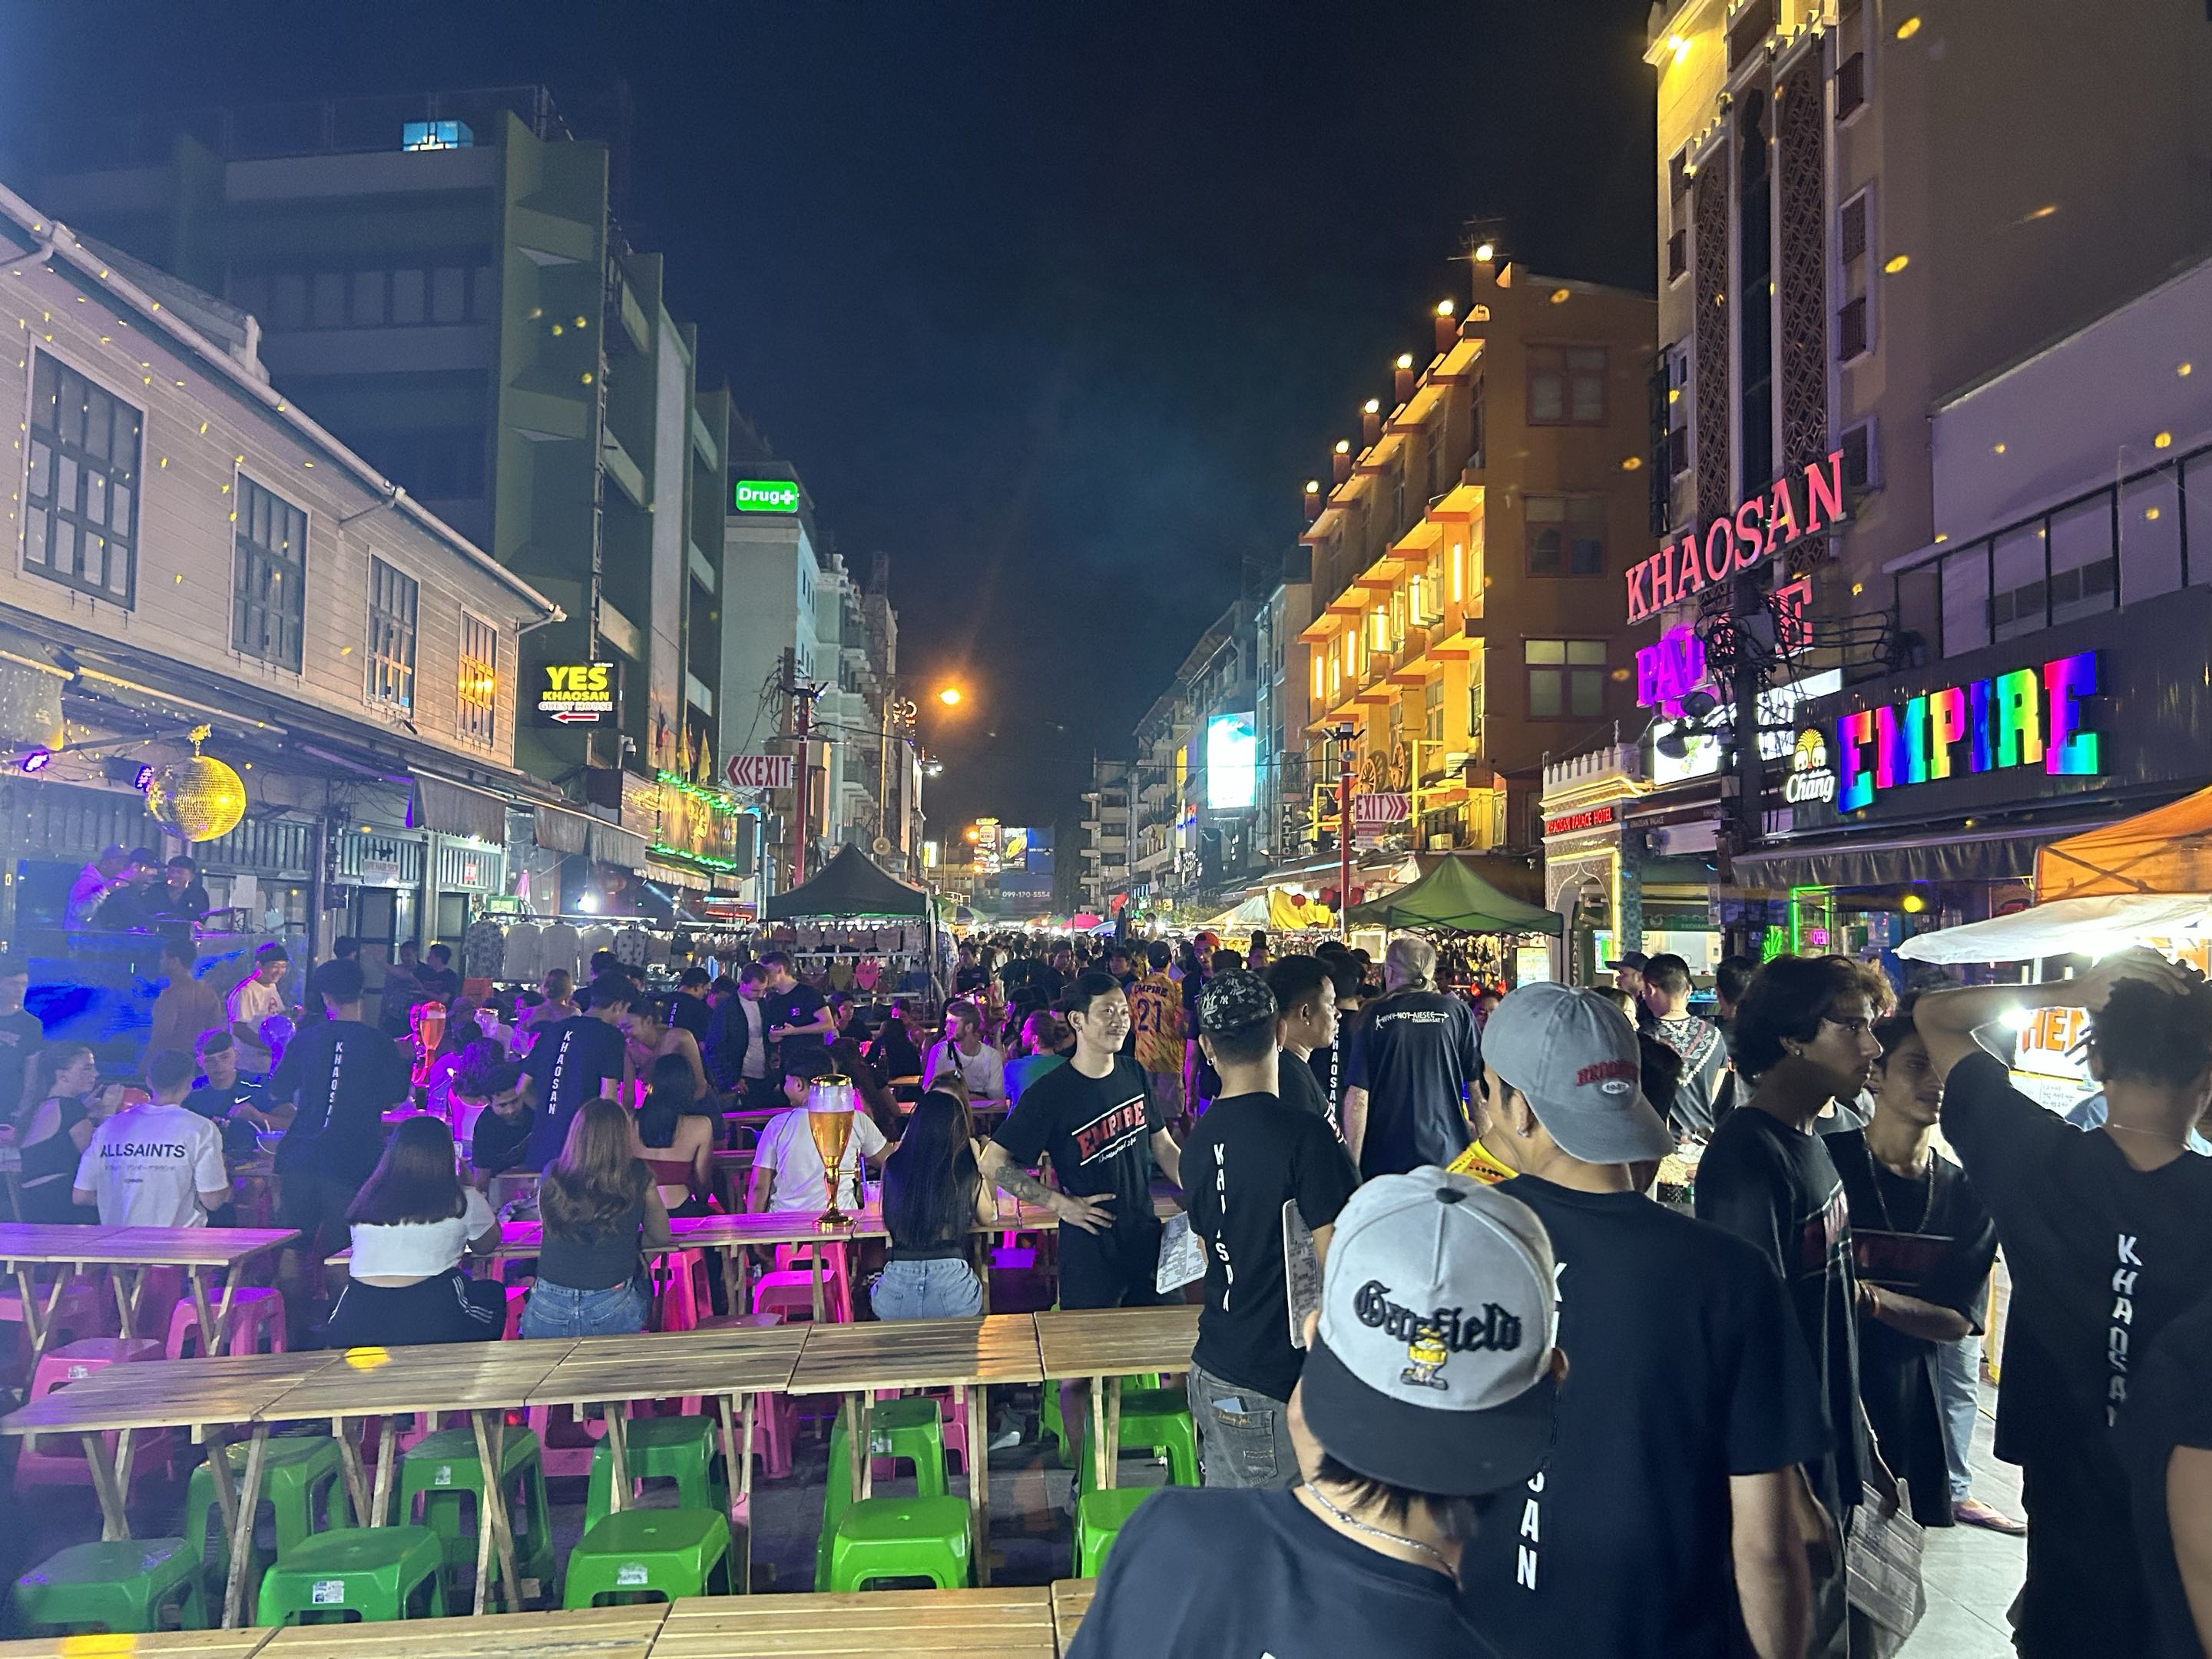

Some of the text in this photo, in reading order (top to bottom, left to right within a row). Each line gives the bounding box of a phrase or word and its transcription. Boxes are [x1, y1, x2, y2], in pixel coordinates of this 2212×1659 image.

[1625, 449, 1845, 624] KHAOSAN
[546, 666, 608, 691] YES
[538, 701, 613, 711] GUEST HOUSE
[542, 691, 610, 701] KHAOSAN
[1837, 651, 2098, 814] EMPIRE
[755, 757, 790, 786] EXIT
[1786, 773, 1836, 803] Chang
[1356, 794, 1384, 820] EXIT
[1571, 813, 1592, 830] PALACE
[1593, 807, 1613, 825] HOTEL
[1813, 931, 1827, 945] OPEN
[1137, 998, 1161, 1032] 21
[548, 1031, 573, 1114] KHAOSAN
[1328, 1035, 1339, 1114] HAOSAN
[1076, 1100, 1145, 1160] EMPIRE
[100, 1144, 185, 1157] ALLSAINTS
